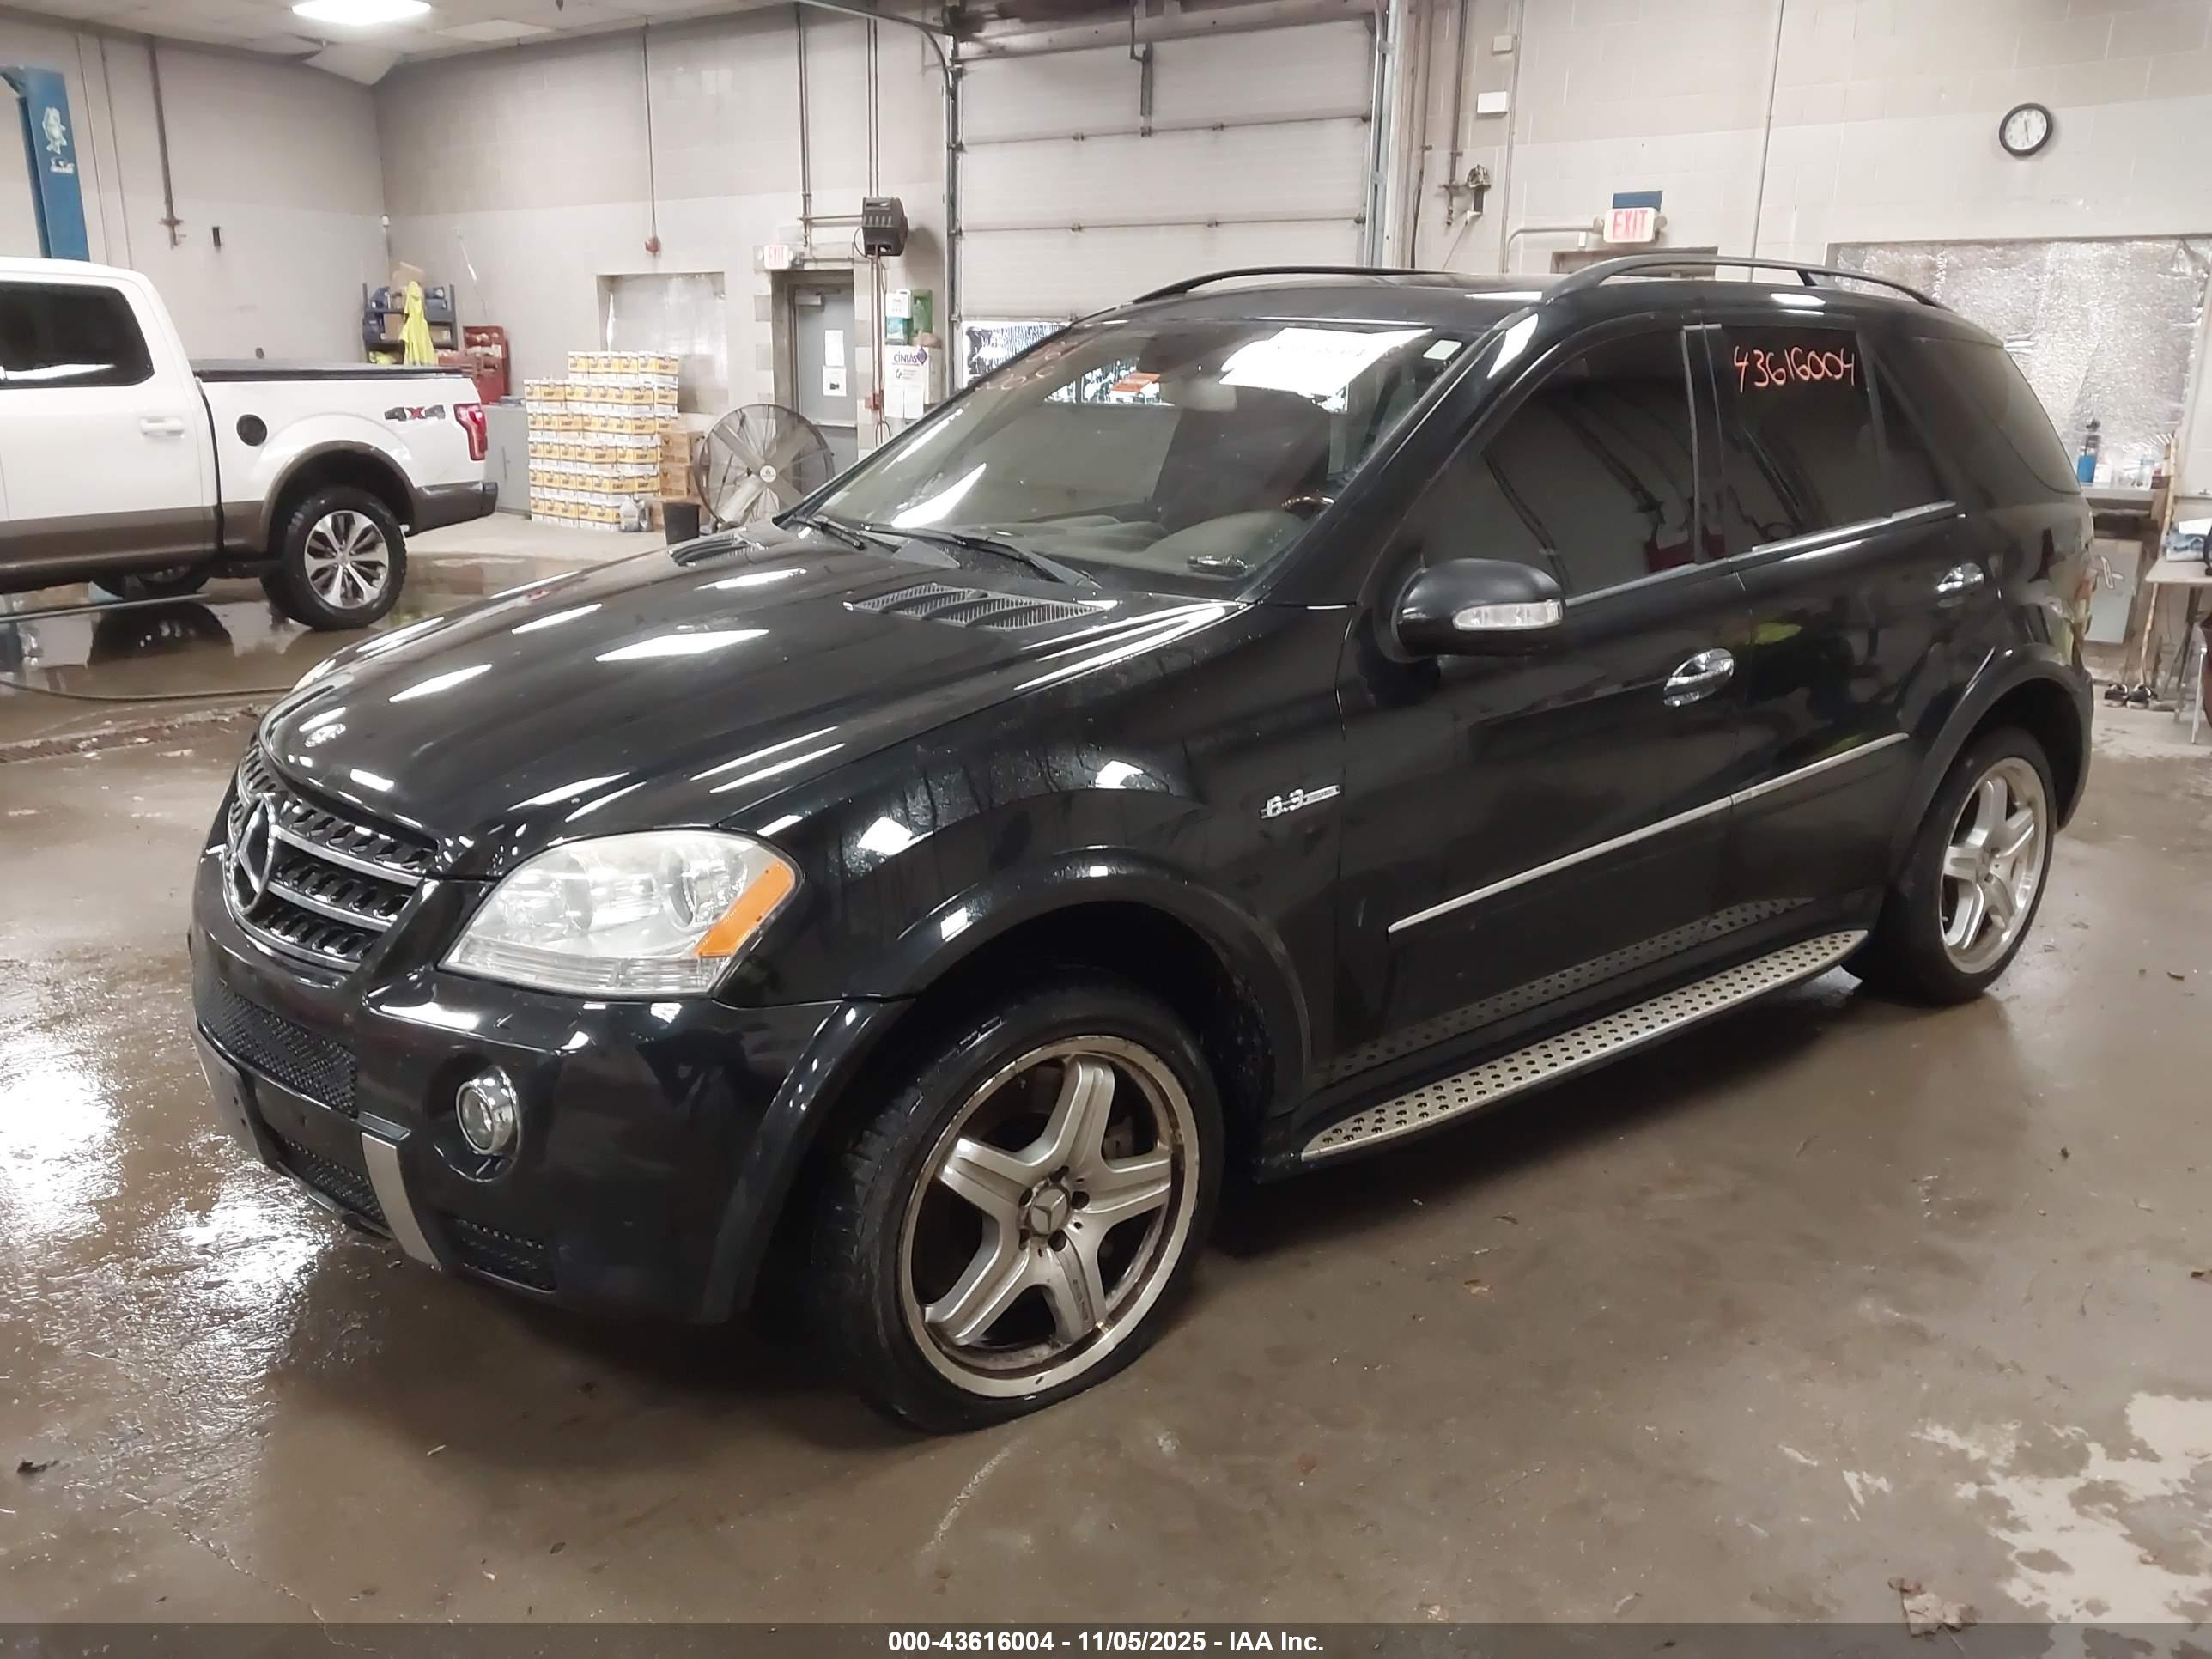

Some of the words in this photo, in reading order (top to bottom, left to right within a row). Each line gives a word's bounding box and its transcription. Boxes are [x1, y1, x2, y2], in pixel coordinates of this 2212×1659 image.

[1613, 210, 1649, 240] EXIT
[1733, 345, 1856, 394] 43616004
[1266, 787, 1304, 817] 6.3
